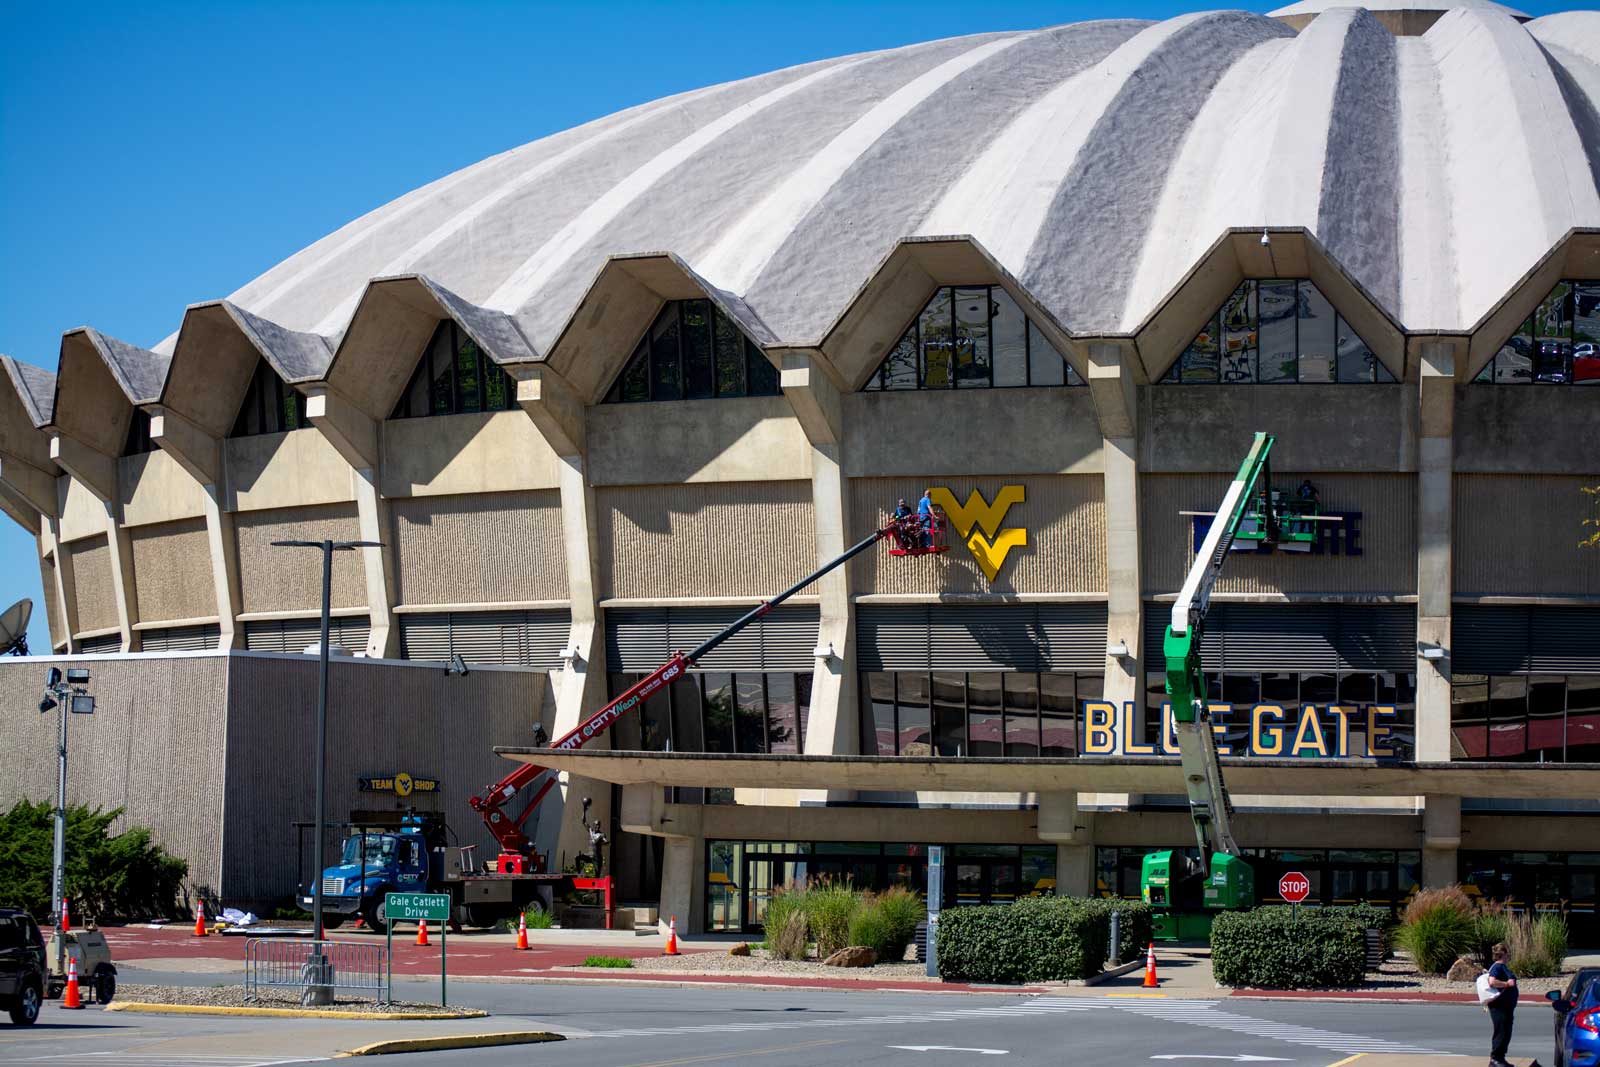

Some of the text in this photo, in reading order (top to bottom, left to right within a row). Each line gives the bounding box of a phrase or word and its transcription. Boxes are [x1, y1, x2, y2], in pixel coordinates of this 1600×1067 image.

[1249, 701, 1397, 757] GATE
[558, 733, 581, 750] OTT
[370, 779, 393, 790] TEAM
[414, 780, 435, 791] SHOP
[1281, 881, 1307, 893] STOP
[390, 896, 445, 907] Gale Catlett
[405, 907, 429, 917] Drive
